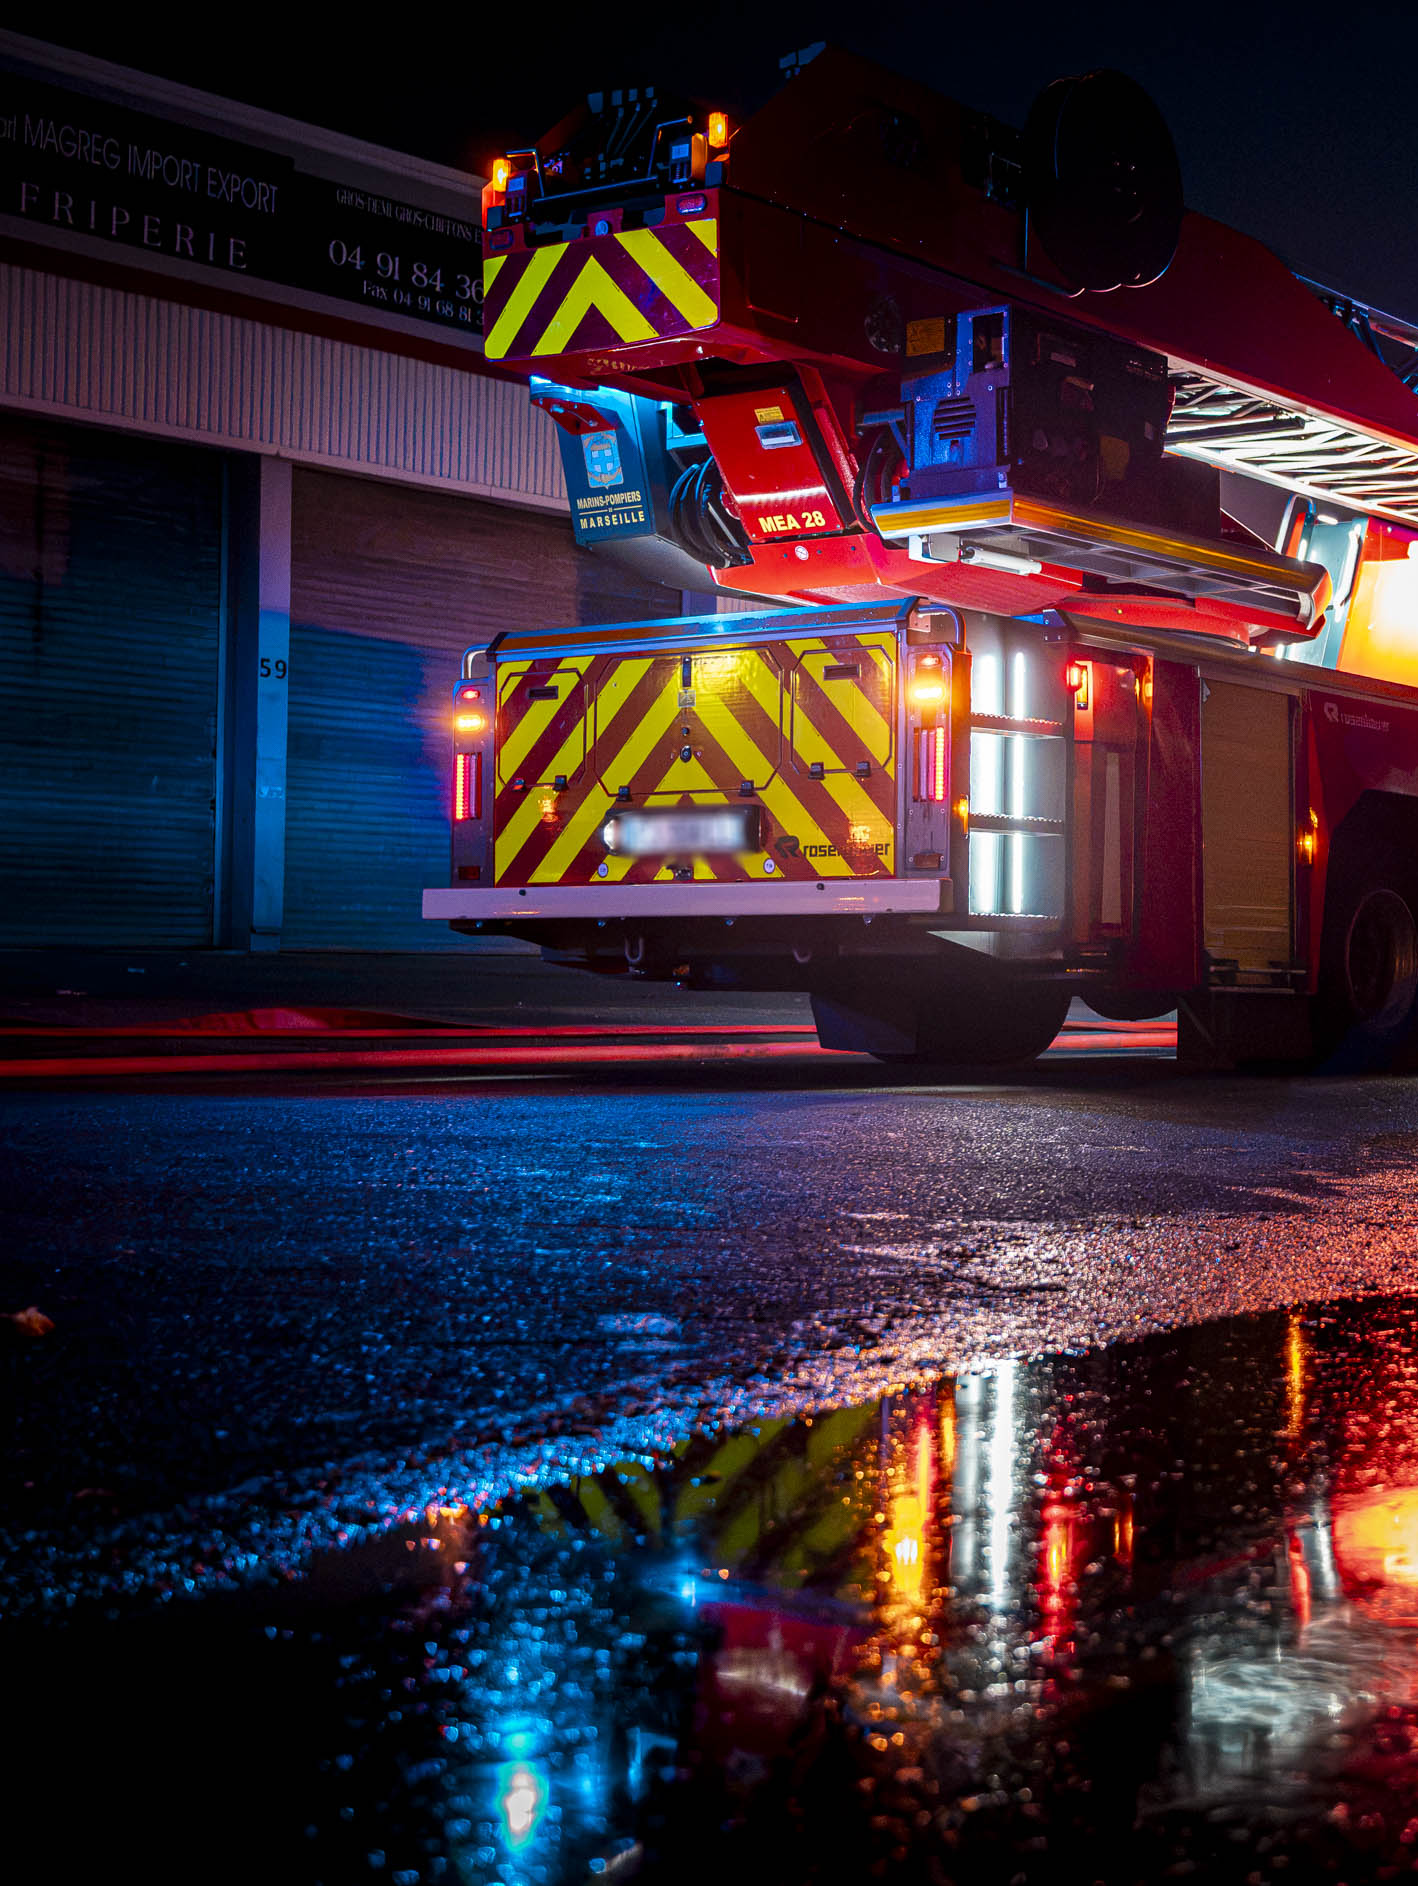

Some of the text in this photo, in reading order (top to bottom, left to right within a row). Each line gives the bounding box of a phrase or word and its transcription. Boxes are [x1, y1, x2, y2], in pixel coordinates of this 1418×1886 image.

[24, 113, 120, 170] MAGREG
[128, 144, 200, 192] IMPORT
[207, 167, 279, 216] EXPORT
[20, 181, 248, 269] FRIPERIE
[328, 240, 484, 305] 04 91 84 36
[417, 295, 431, 312] 91
[576, 490, 642, 510] MARINS-POMPIERS
[580, 510, 646, 529] MARSEILLE
[757, 510, 826, 533] MEA 28
[260, 658, 287, 679] 59
